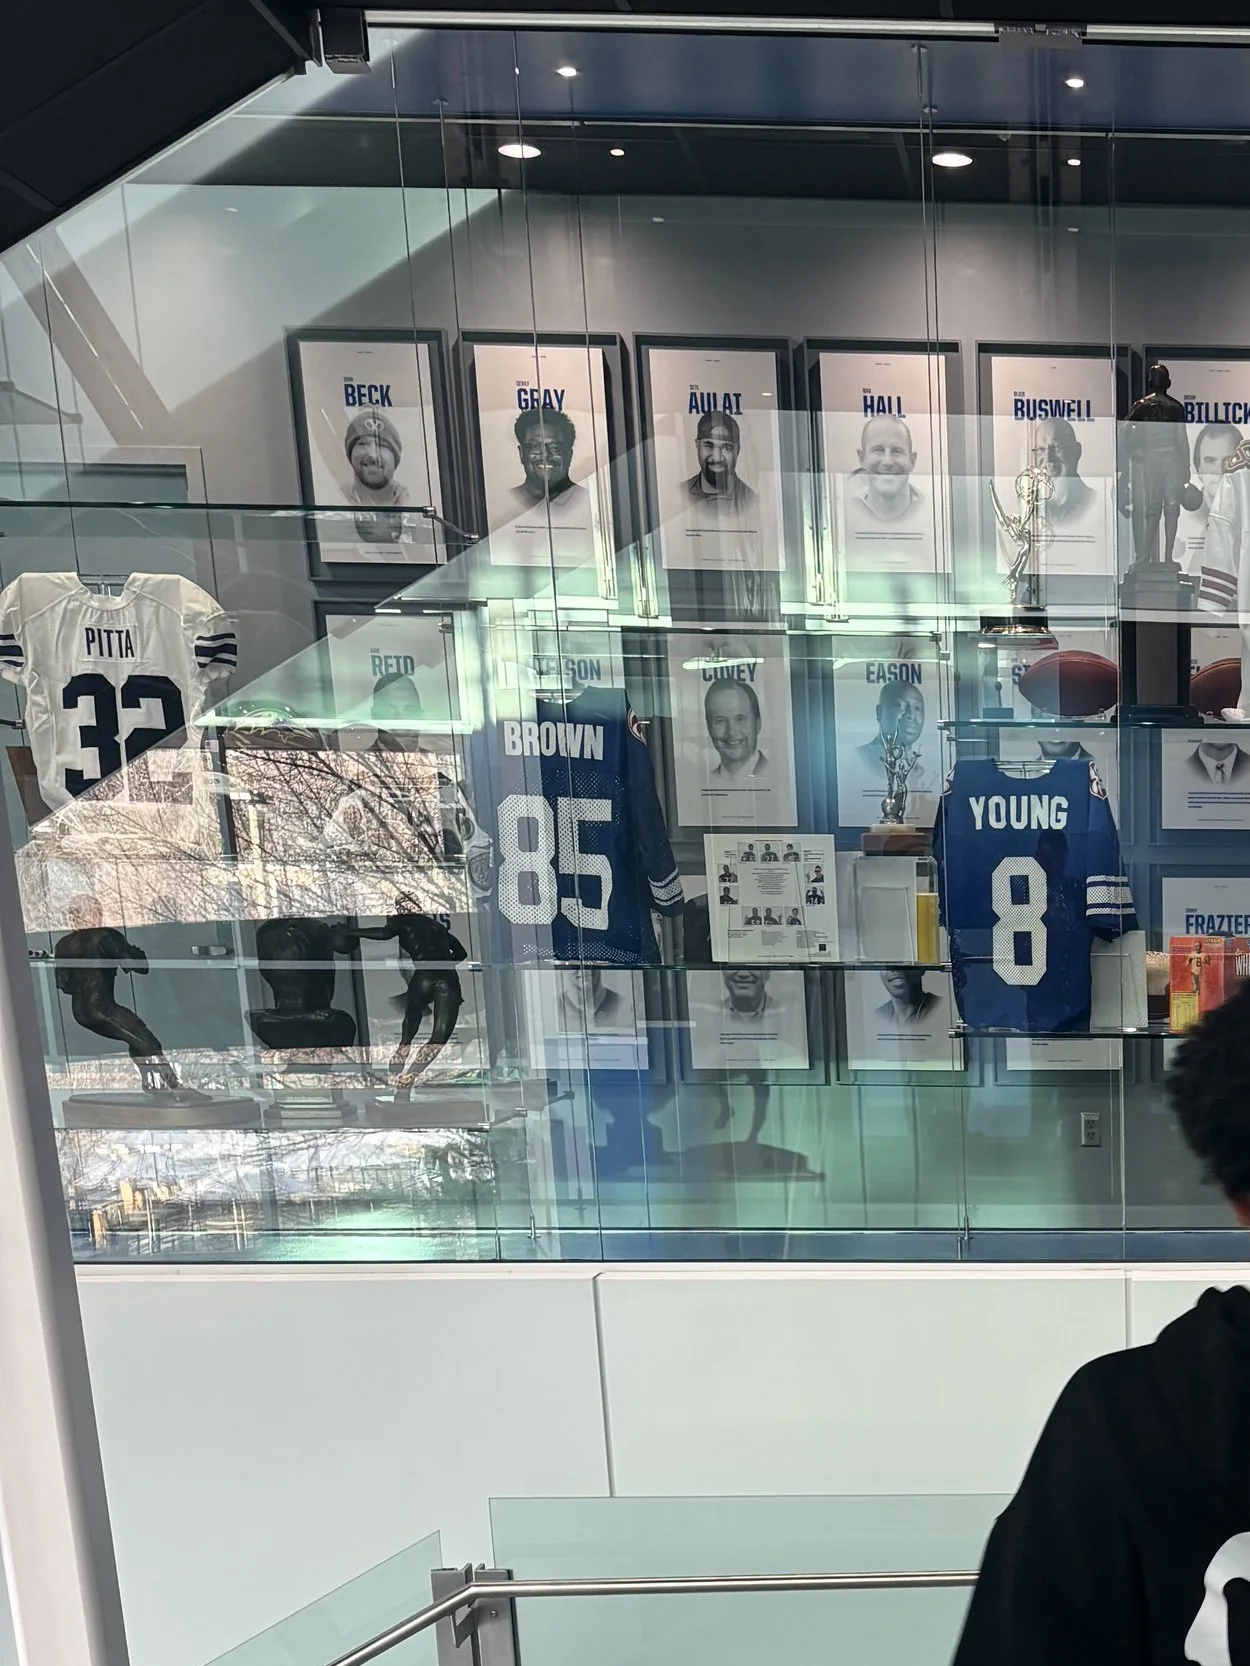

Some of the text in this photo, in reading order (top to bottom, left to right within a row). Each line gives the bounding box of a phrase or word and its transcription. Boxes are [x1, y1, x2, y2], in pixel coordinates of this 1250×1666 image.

[344, 384, 392, 407] BECK
[517, 388, 565, 411] GRAY
[863, 395, 906, 418] HALL
[1014, 399, 1095, 422] BUSWELL
[84, 627, 136, 658] PITTA
[866, 663, 922, 685] EASON
[62, 673, 194, 805] 32
[504, 720, 604, 760] BROWN
[968, 795, 1069, 830] YOUNG
[498, 793, 614, 930] 85
[992, 856, 1048, 985] 8
